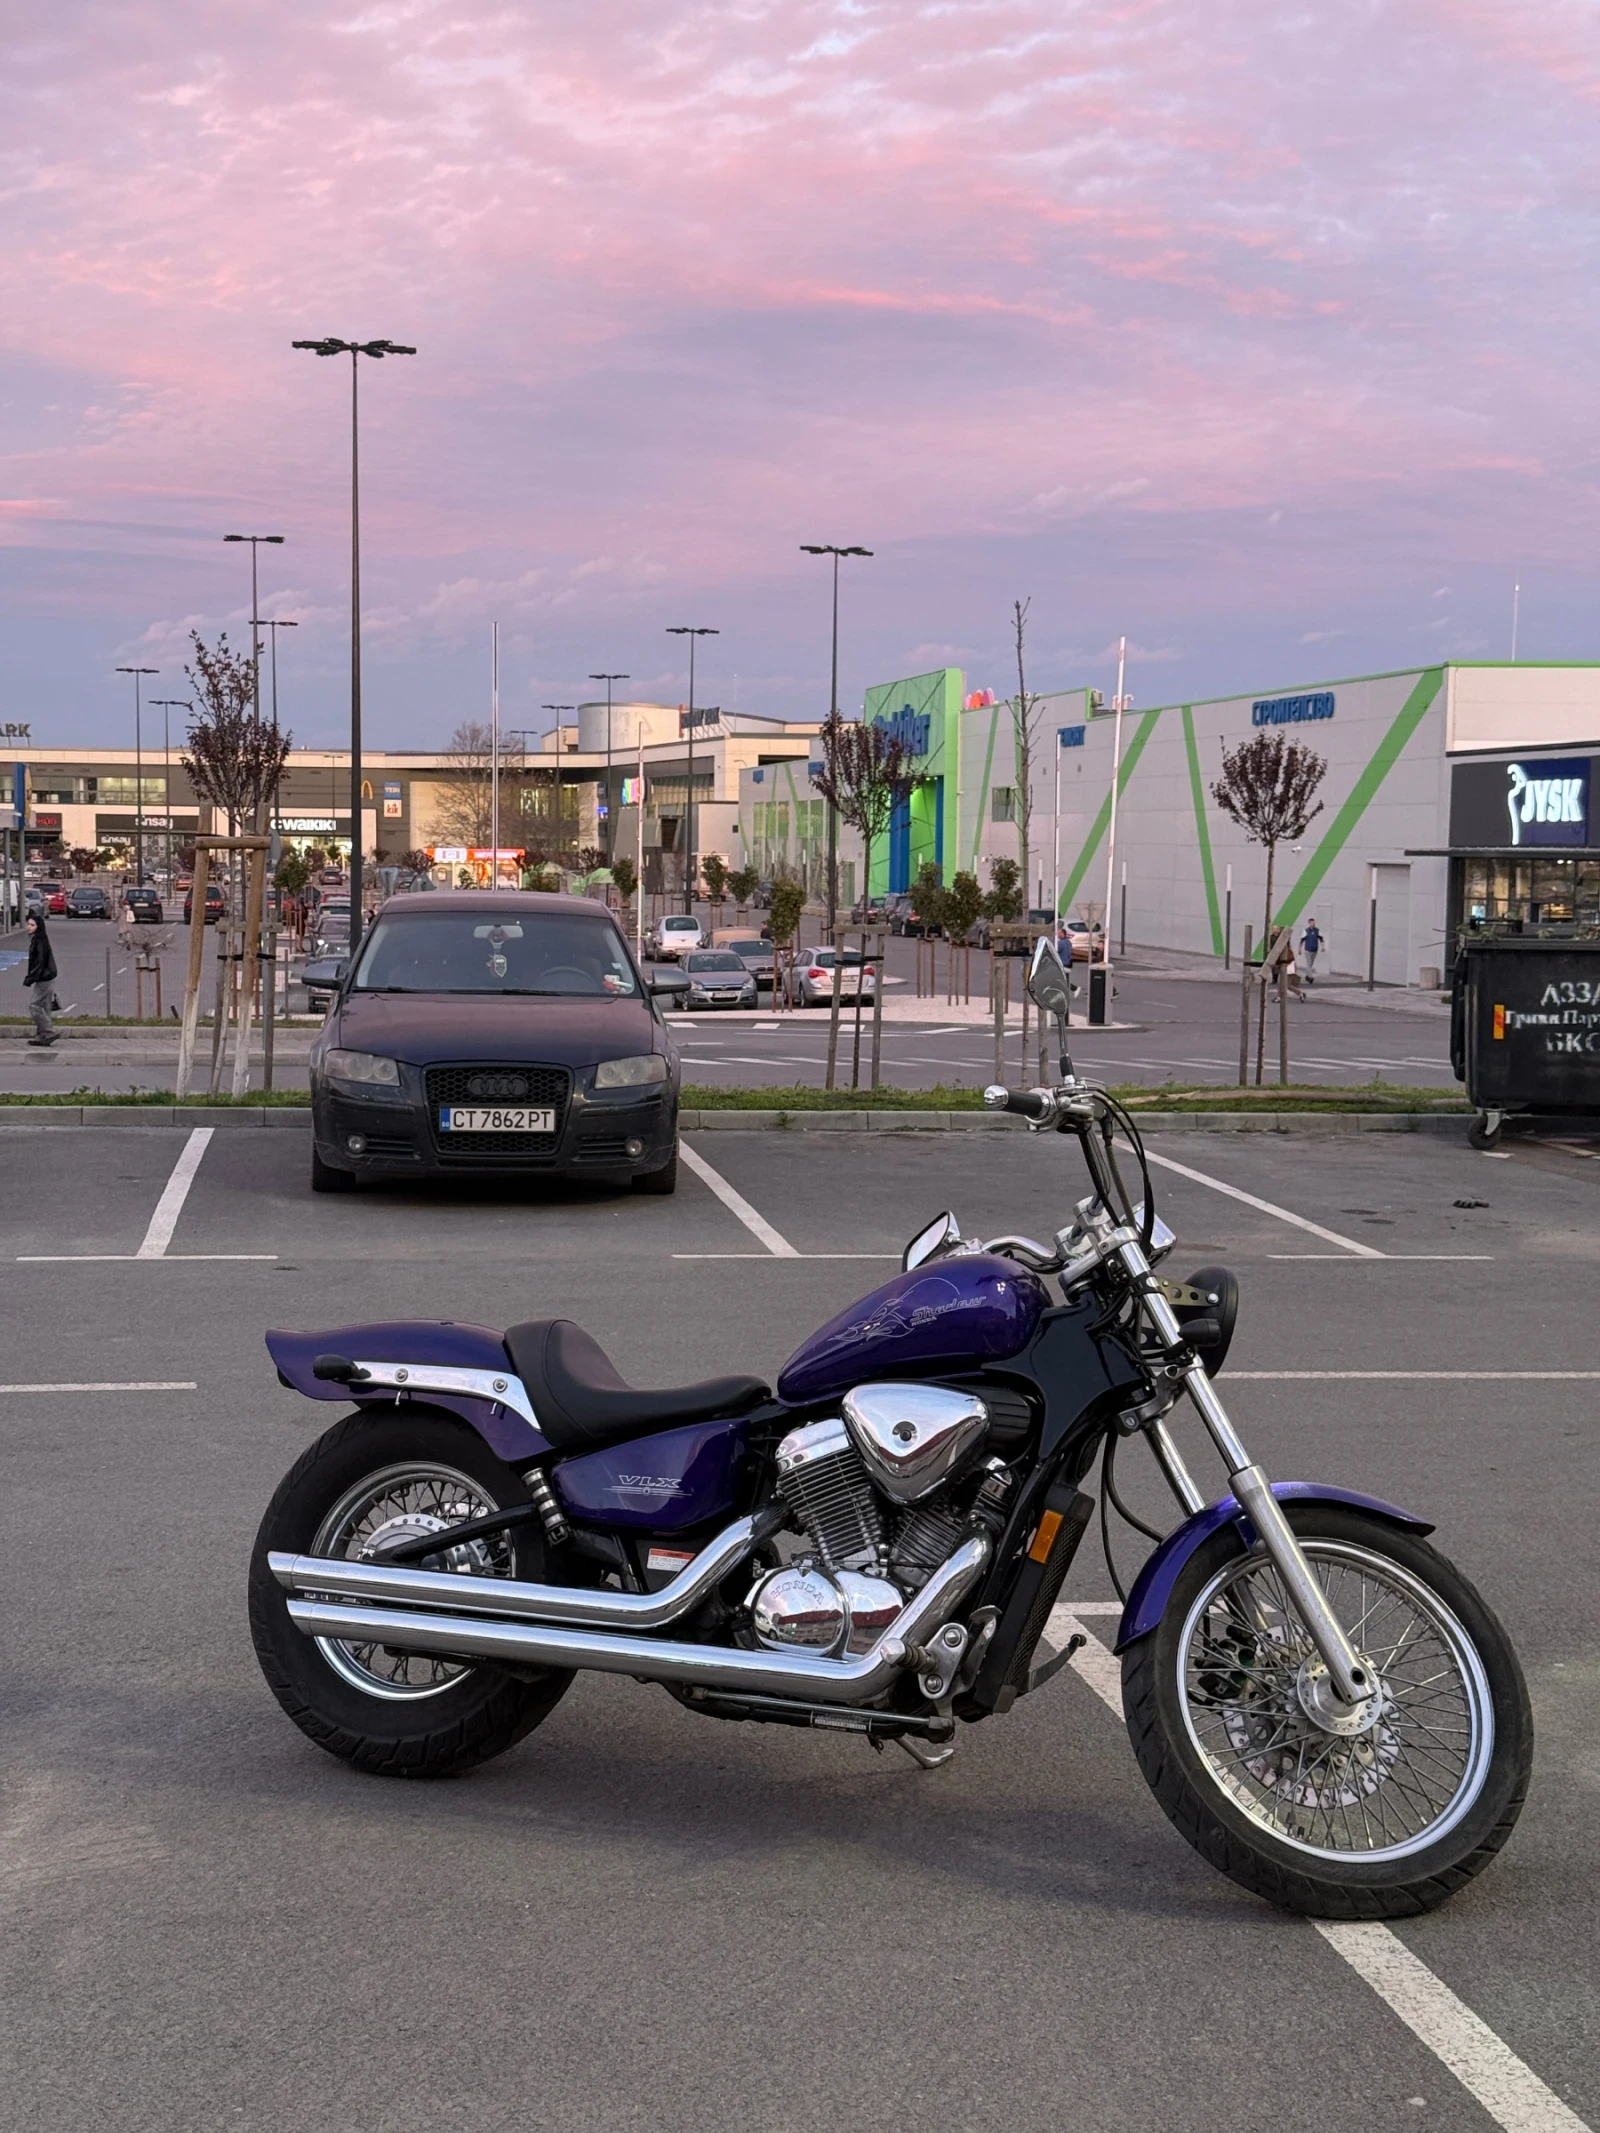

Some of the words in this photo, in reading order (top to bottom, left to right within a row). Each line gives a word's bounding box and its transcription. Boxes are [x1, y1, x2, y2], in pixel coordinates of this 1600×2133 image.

[1252, 692, 1335, 726] СТРОИТЕЛСТВО
[1520, 778, 1583, 823] JYSK
[101, 834, 131, 846] sinsay
[480, 1110, 525, 1129] 7862
[910, 1296, 987, 1322] Shadow
[911, 1315, 937, 1327] HONDA
[618, 1474, 682, 1489] VLX
[770, 1580, 824, 1606] HONDA
